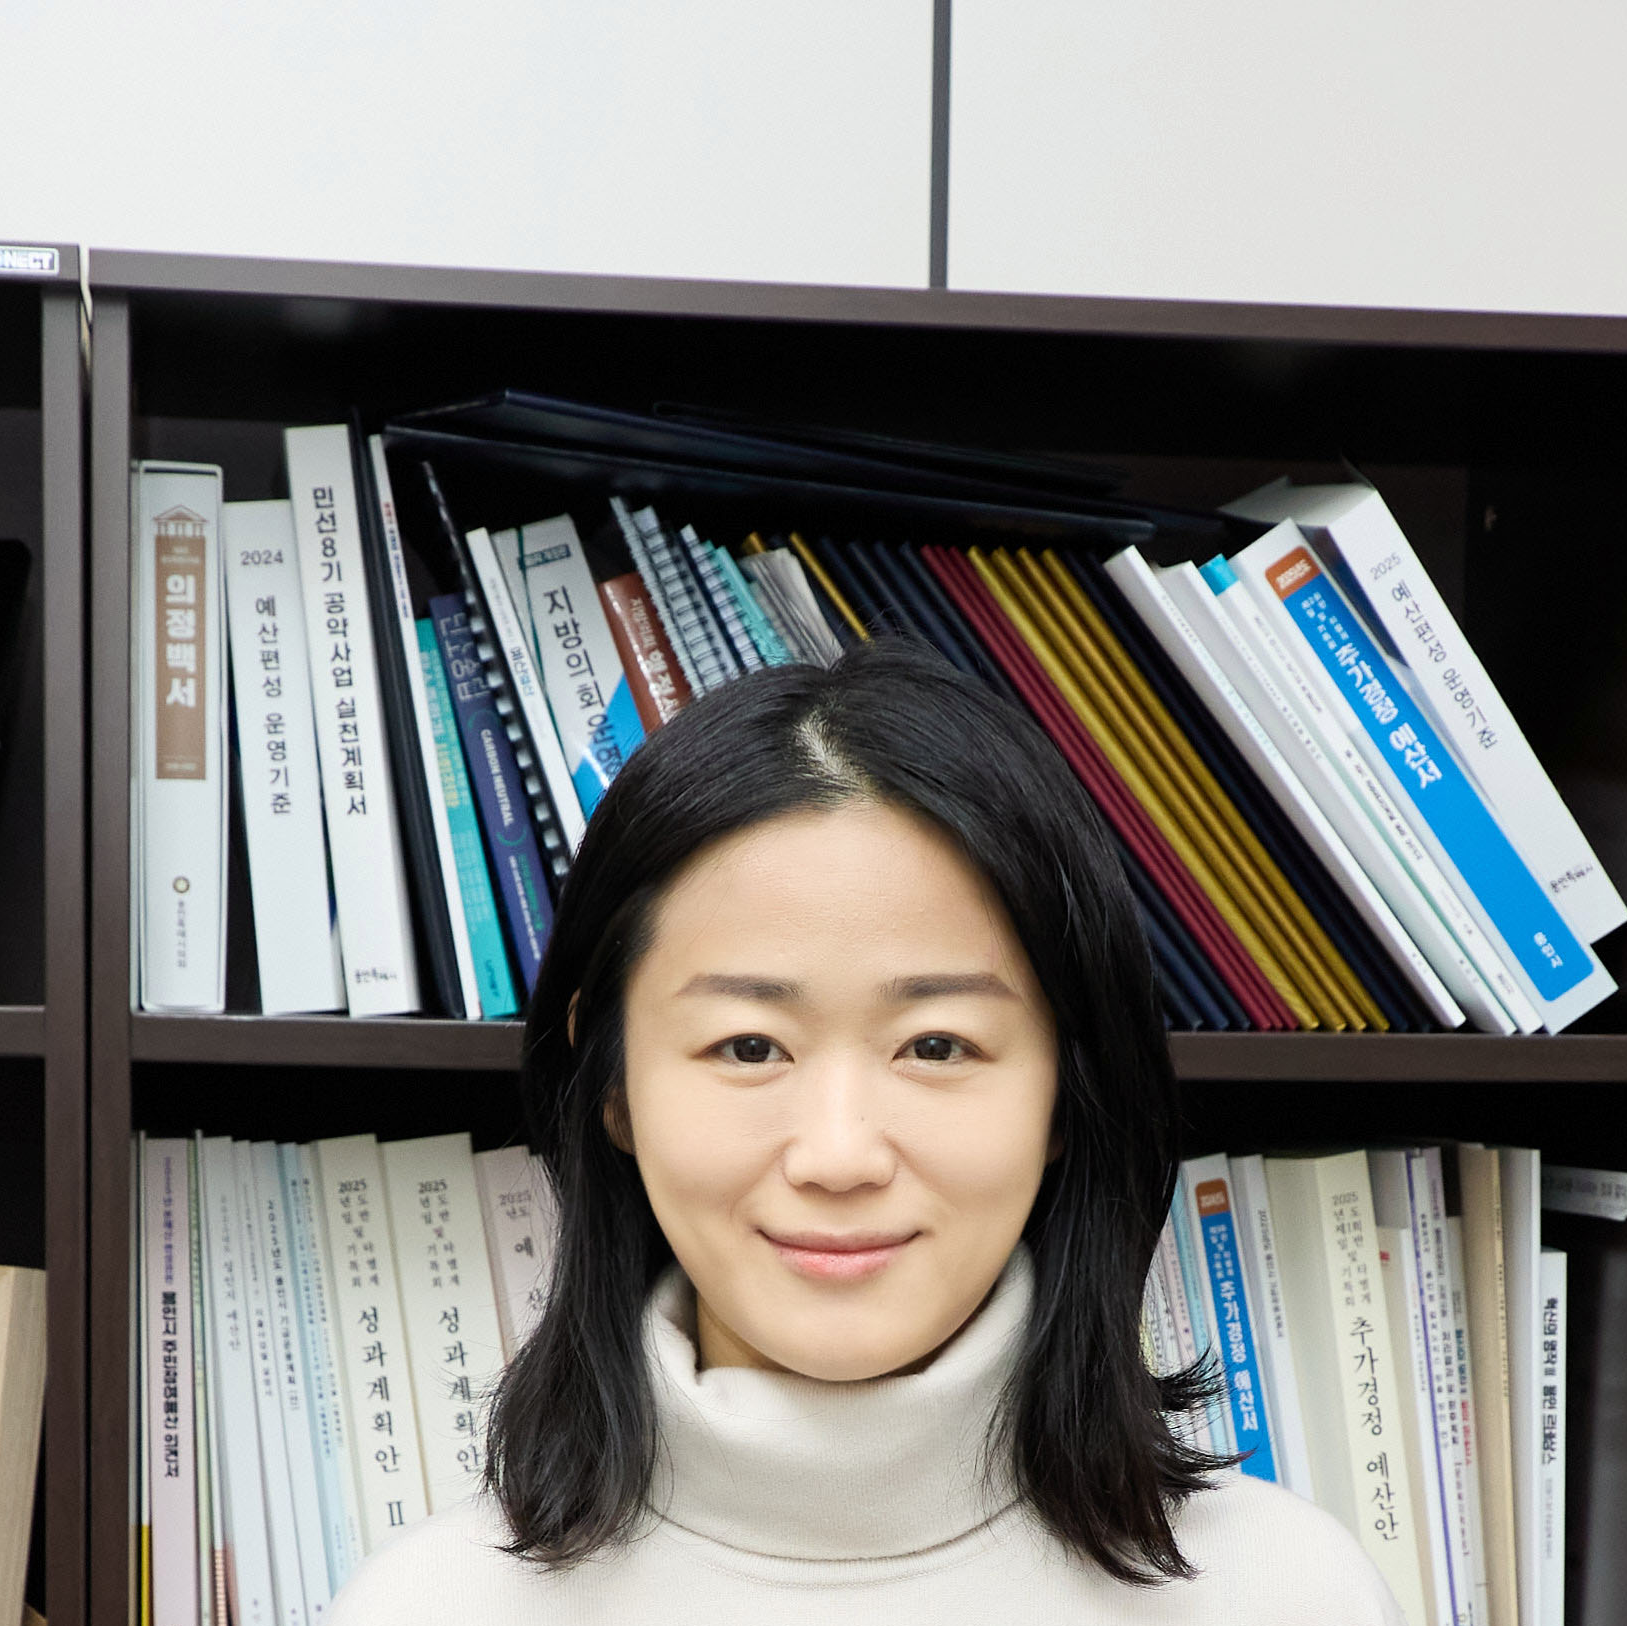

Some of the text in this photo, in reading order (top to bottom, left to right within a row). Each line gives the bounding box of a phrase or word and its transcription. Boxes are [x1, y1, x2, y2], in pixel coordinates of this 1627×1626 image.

[240, 548, 284, 568] 2024
[1369, 553, 1402, 580] 2025
[166, 575, 195, 707] 의정백서
[255, 596, 292, 815] 예산편성 운영기준
[311, 486, 367, 816] 민선8기 공약사업 실천계획서
[1335, 641, 1399, 727] 추가경정
[1389, 723, 1442, 790] 예산서
[1391, 580, 1499, 750] 예산편성 운영기준
[338, 1179, 367, 1194] 2025
[419, 1178, 448, 1194] 2025
[357, 1305, 402, 1475] 성과계획안
[1350, 1318, 1400, 1542] 추가경정 예산안
